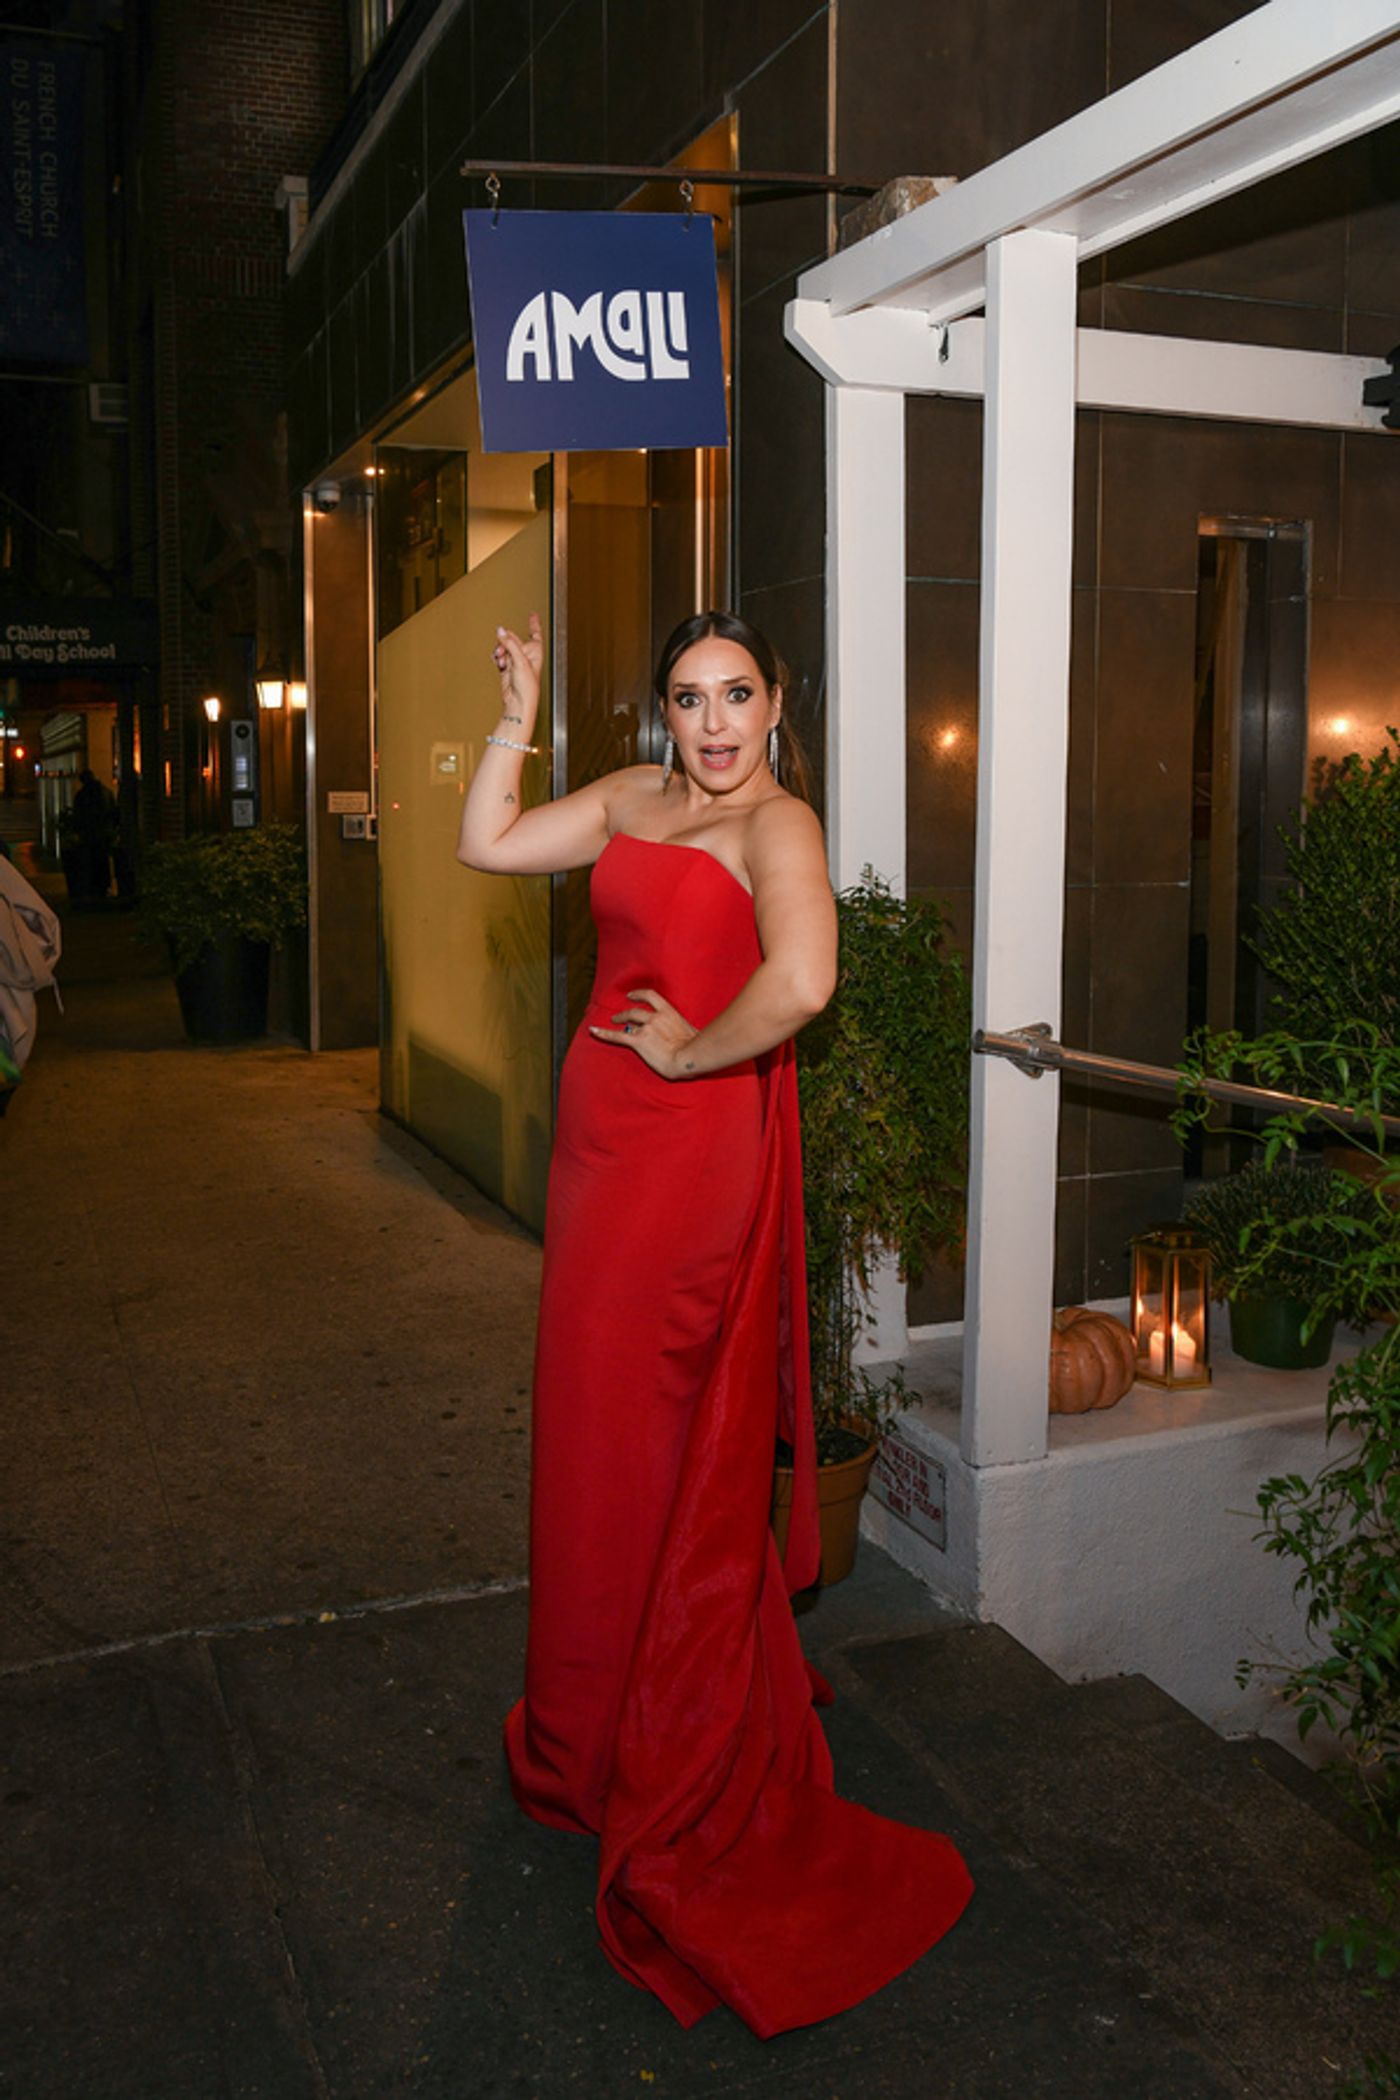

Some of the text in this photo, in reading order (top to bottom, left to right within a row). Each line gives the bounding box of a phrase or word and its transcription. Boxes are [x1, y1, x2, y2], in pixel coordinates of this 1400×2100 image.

[10, 55, 36, 241] DU SAINT-ESPRIT
[38, 60, 60, 240] FRENCH CHURCH
[6, 624, 91, 641] Children's
[14, 643, 54, 664] Day
[56, 643, 117, 664] School
